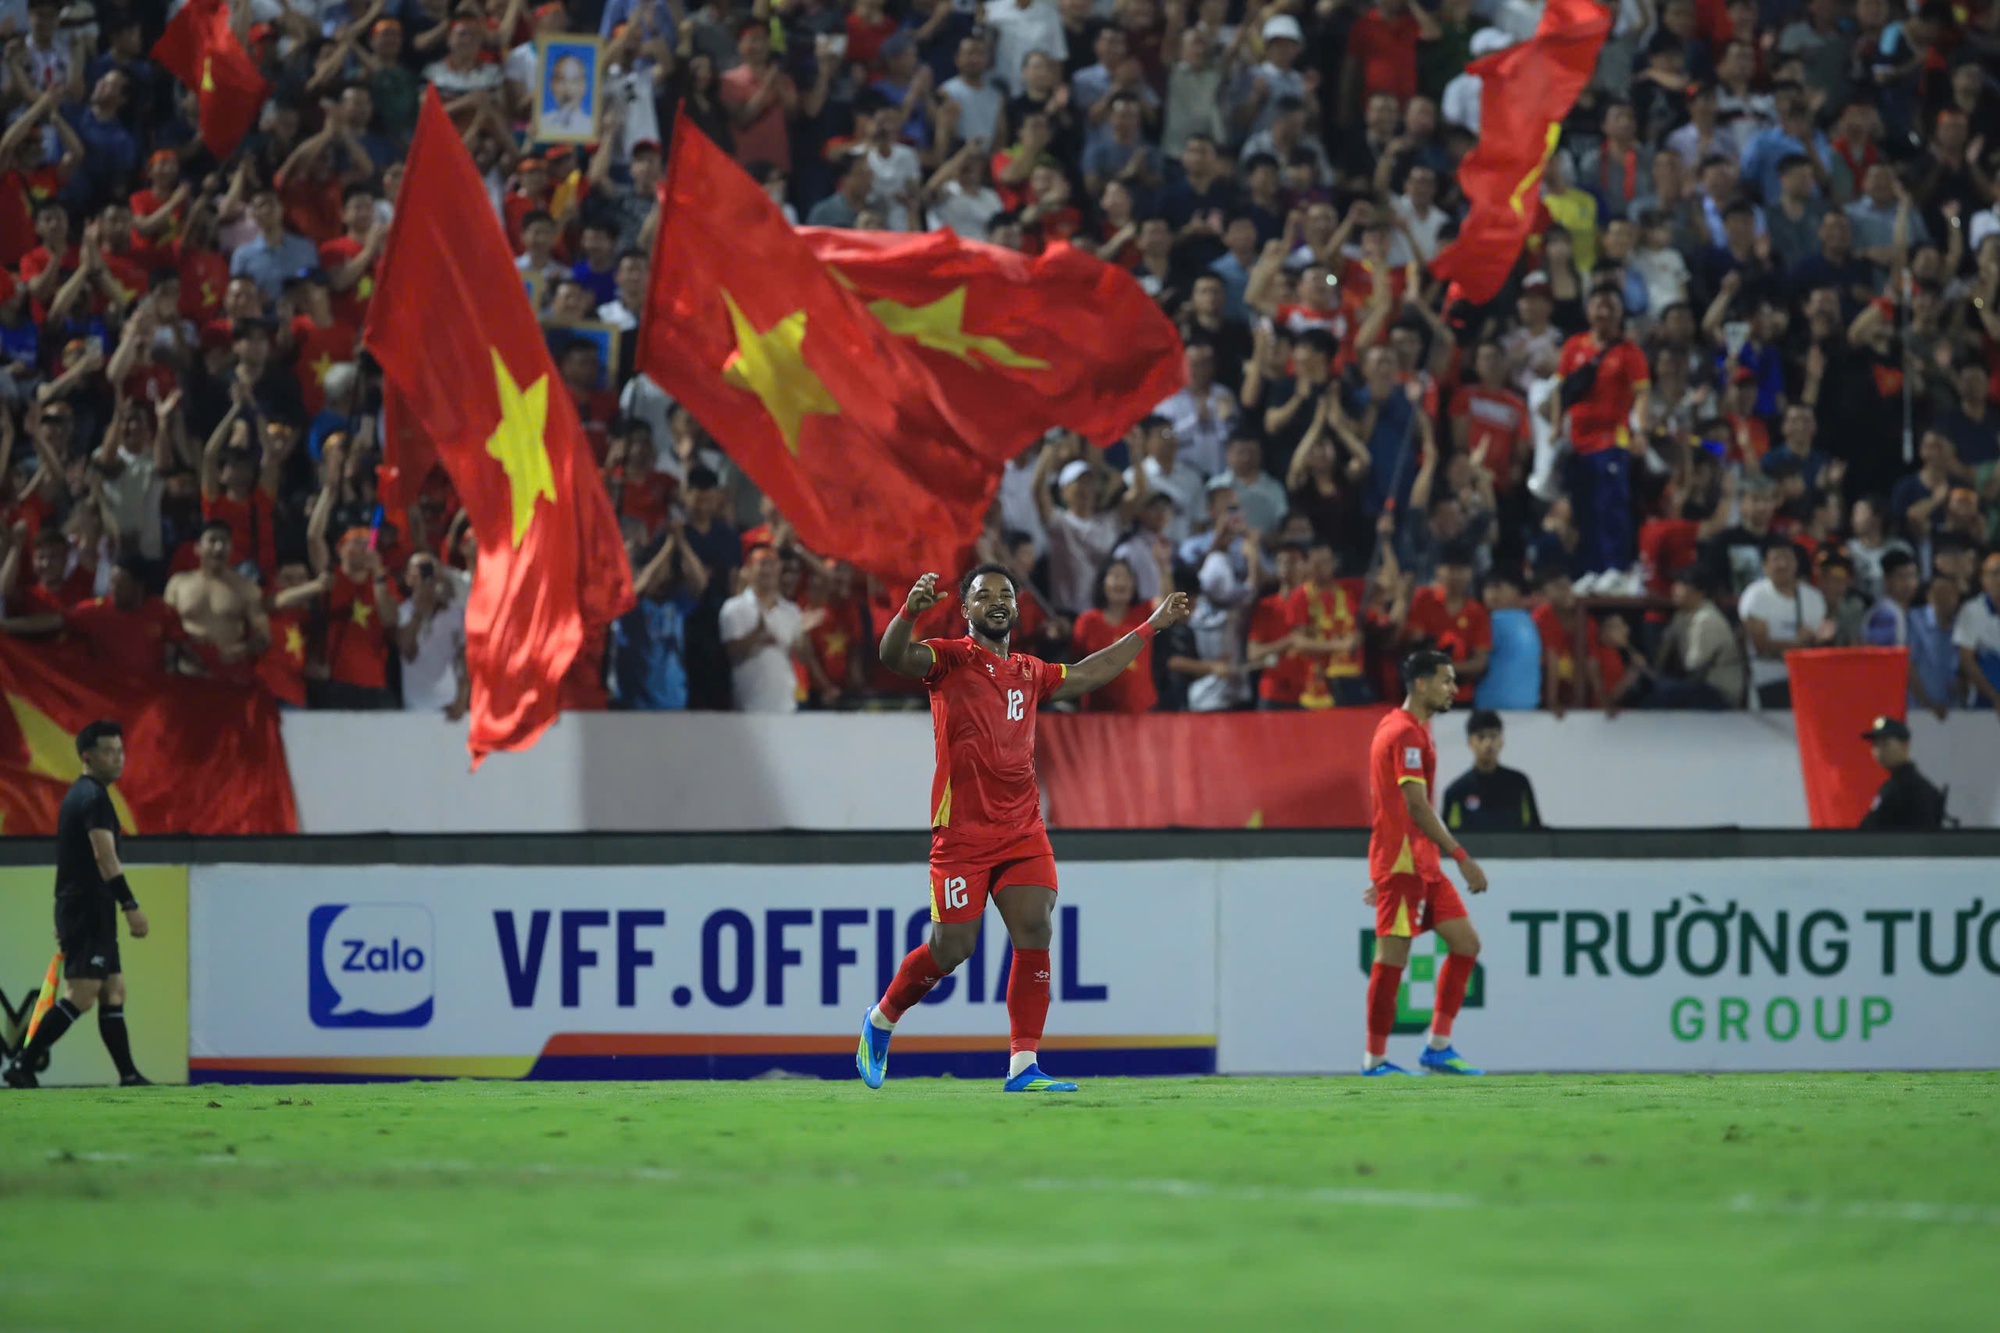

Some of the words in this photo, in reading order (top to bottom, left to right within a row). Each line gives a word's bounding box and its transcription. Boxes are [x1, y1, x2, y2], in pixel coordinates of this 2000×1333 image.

[1006, 688, 1024, 722] 12
[943, 875, 969, 910] 12
[340, 937, 425, 973] Zalo
[1508, 892, 1850, 978] TRƯỜNG
[492, 905, 1108, 1007] VFF.OFFICIL
[1669, 995, 1893, 1042] GROUP
